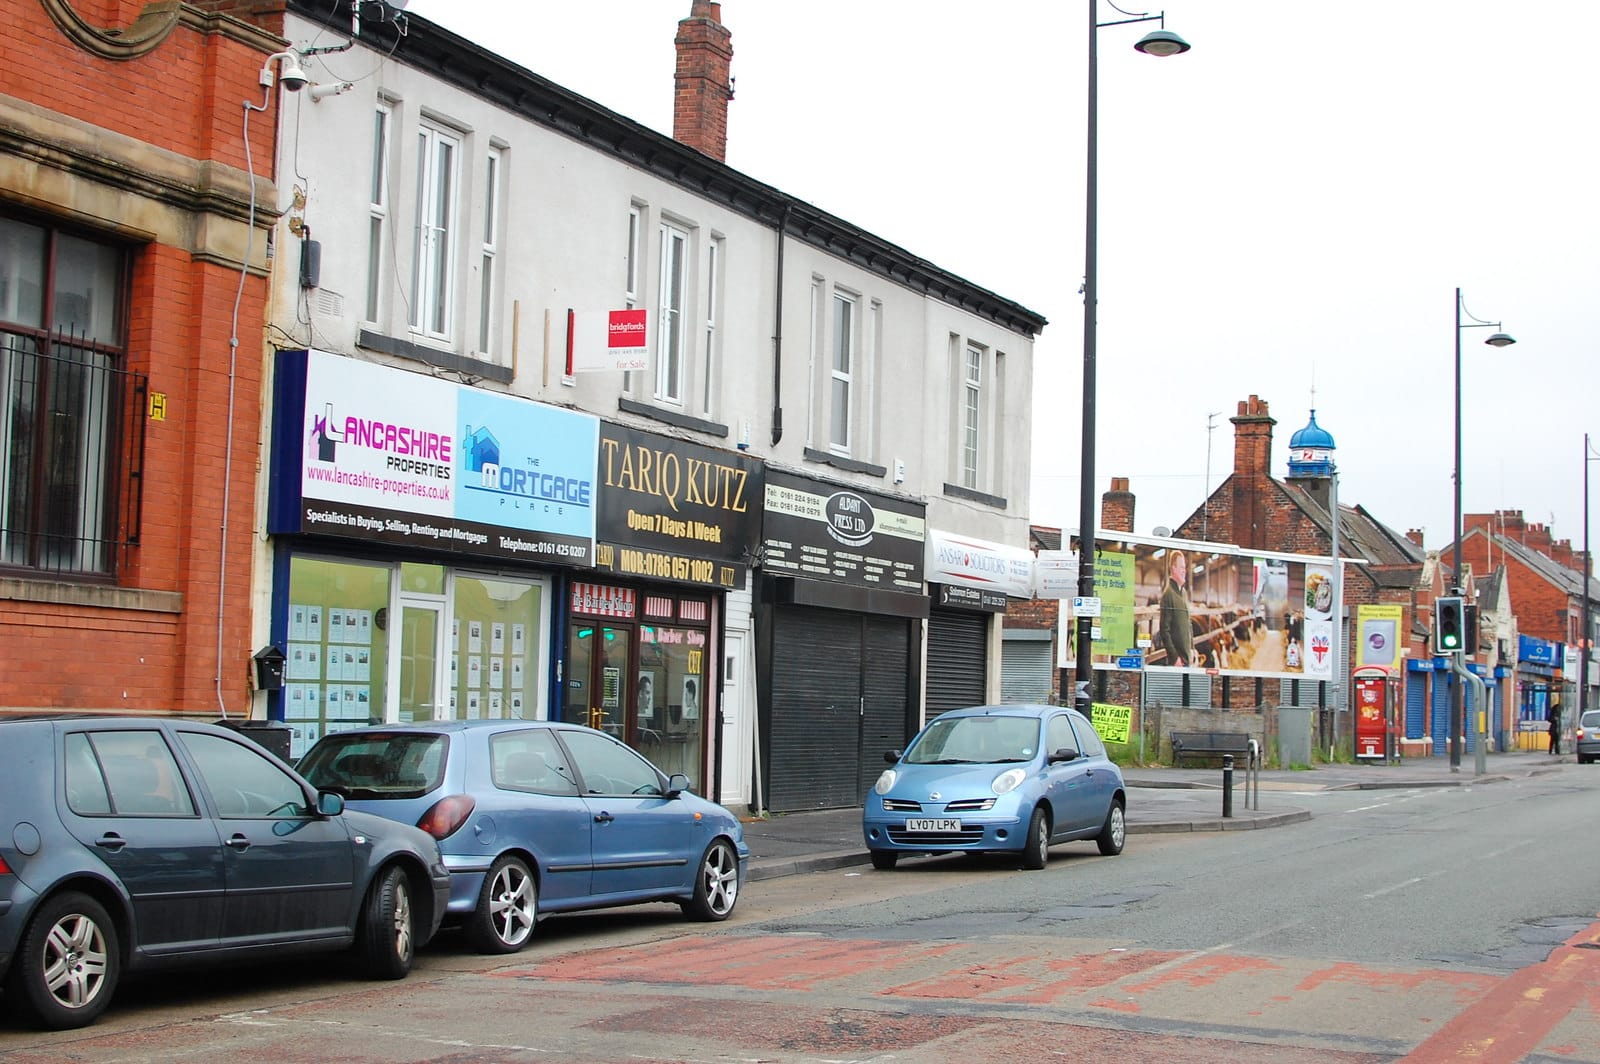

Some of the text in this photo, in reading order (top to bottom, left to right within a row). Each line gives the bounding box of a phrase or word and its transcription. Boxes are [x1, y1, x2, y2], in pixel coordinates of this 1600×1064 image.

[630, 360, 646, 368] Sale
[386, 456, 450, 480] PROPERTIES
[526, 457, 540, 468] THE
[602, 438, 748, 512] TARIQ KUTZ
[308, 466, 450, 501] www.lancashire-properties.co.uk
[306, 509, 586, 558] Specialists in Buying, Selling, Renting and Mortgages Telephone: 0161 425 0207
[628, 510, 722, 543] Open 7 Days A Week
[834, 514, 852, 530] PRESS
[854, 518, 866, 533] LTD
[596, 544, 614, 571] TARIQ
[672, 557, 690, 580] 057
[690, 560, 714, 584] 1002
[1110, 709, 1130, 718] FAIR
[910, 820, 956, 830] LY07 LPK
